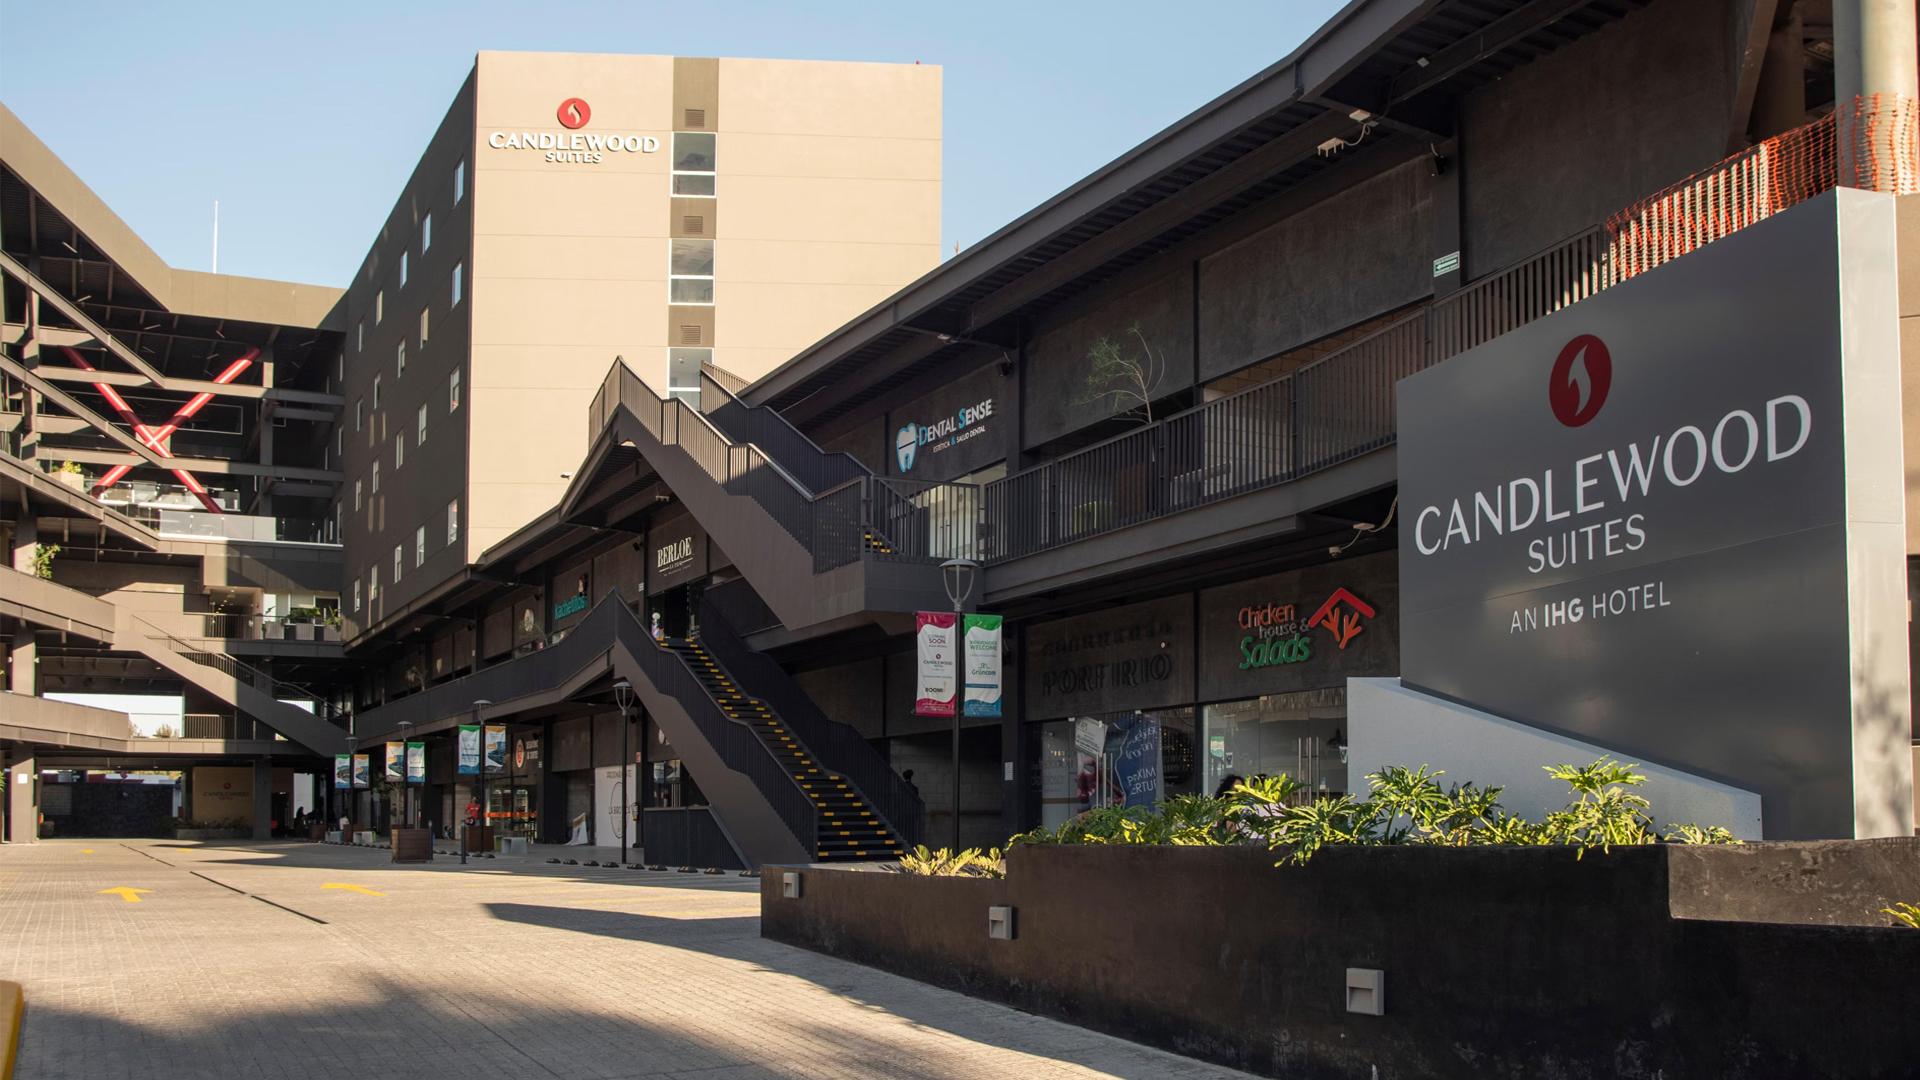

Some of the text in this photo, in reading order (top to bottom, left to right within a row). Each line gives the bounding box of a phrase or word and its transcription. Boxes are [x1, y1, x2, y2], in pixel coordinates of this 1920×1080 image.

[489, 131, 660, 153] CANDLEWOOD
[545, 152, 603, 163] SUITES
[919, 398, 992, 446] DENTAL SENSE
[970, 425, 986, 438] DENTAL
[1414, 394, 1812, 556] CANDLEWOOD
[657, 536, 692, 568] BERLOE
[1527, 513, 1646, 573] SUITES
[1239, 602, 1295, 630] Chicken
[1509, 581, 1671, 634] AN IHG HOTEL
[1259, 617, 1310, 639] house &
[1239, 633, 1310, 669] Salads
[1042, 653, 1172, 697] PORFIRIO
